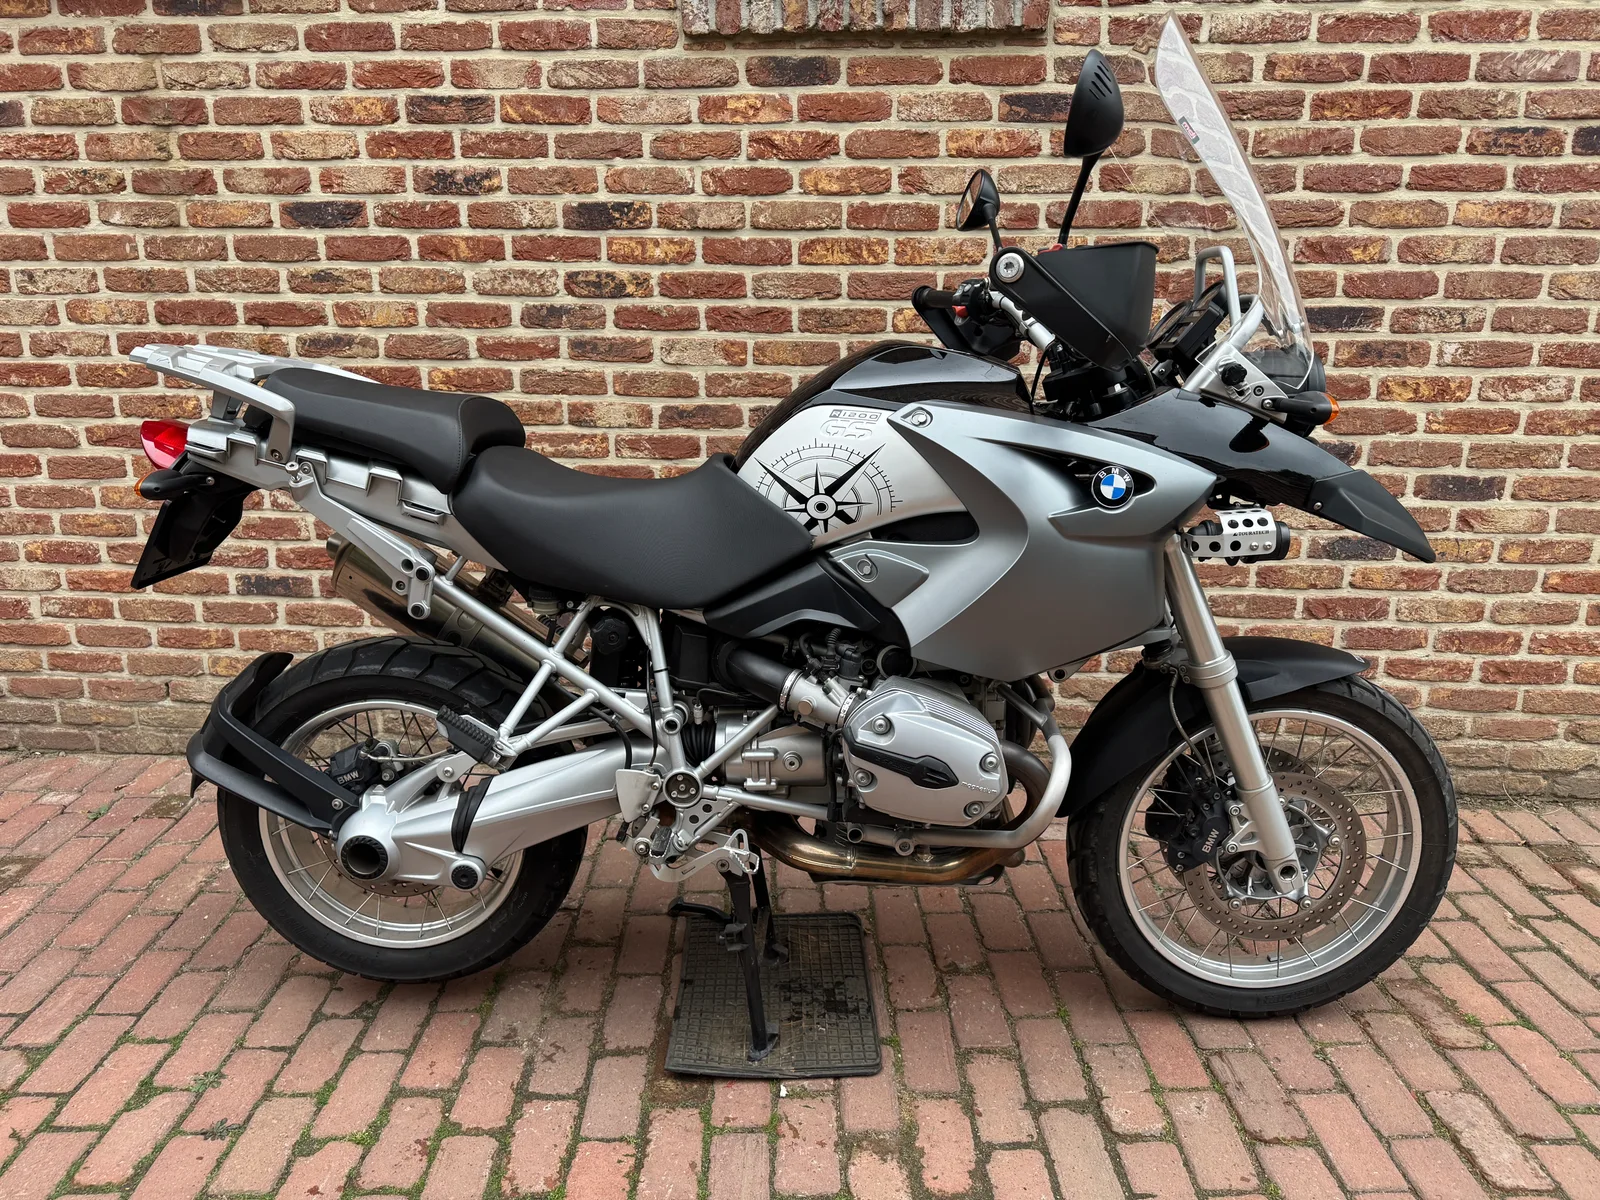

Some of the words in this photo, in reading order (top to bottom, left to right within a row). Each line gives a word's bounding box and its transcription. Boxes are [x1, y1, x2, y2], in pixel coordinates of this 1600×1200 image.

[820, 419, 876, 439] GS
[1098, 467, 1131, 483] BMW
[338, 770, 359, 786] BMW
[1201, 828, 1220, 854] BMW
